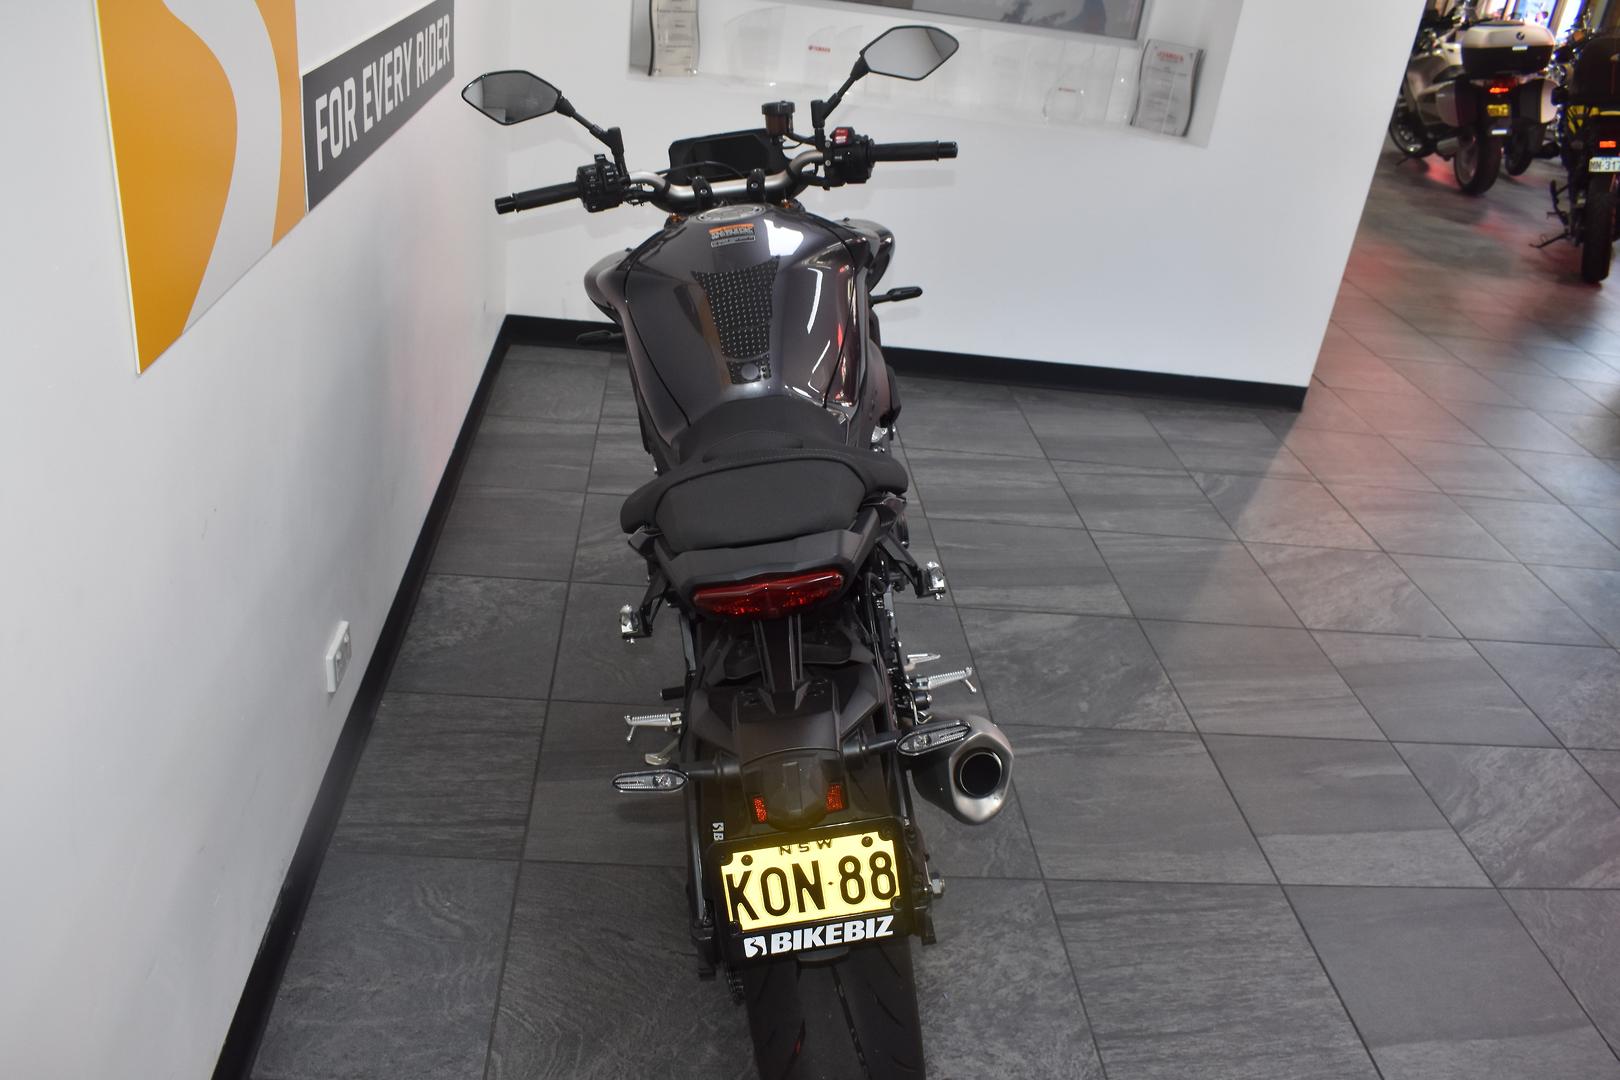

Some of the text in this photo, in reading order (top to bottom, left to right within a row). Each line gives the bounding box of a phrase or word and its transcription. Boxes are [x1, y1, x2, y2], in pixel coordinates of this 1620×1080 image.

[315, 14, 450, 172] FOR EVERY RIDER
[779, 838, 833, 856] NSW
[770, 914, 894, 954] BIKEBIZ
